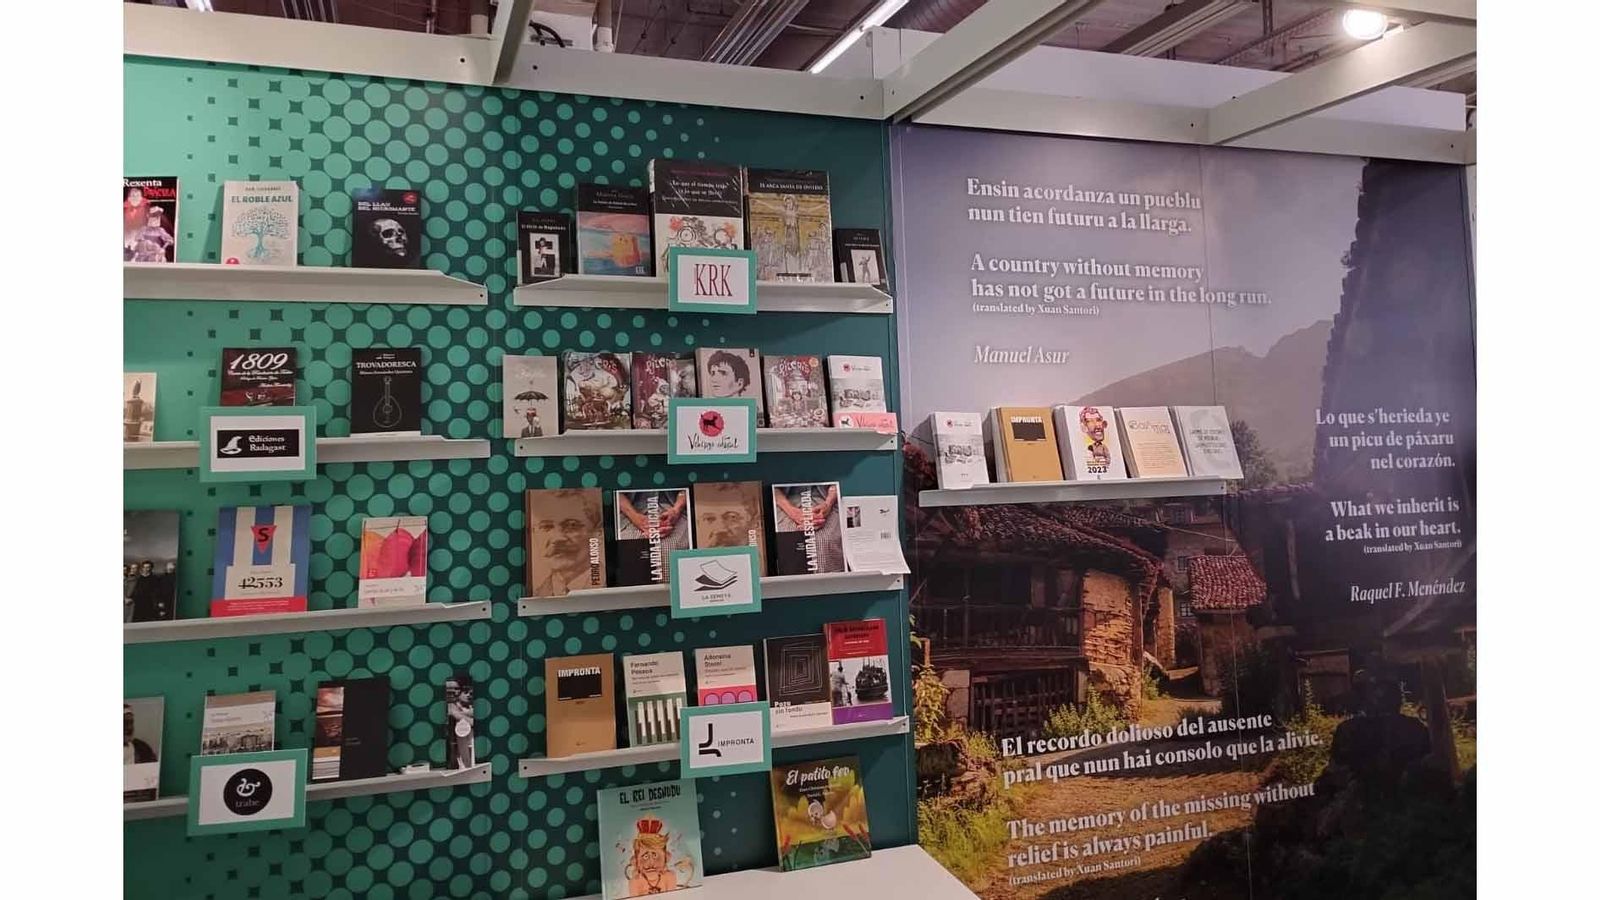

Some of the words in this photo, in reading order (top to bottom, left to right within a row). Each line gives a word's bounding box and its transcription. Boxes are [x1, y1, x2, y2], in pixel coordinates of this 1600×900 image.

[967, 177, 1020, 198] Ensin
[1023, 184, 1115, 205] acordanza
[1119, 190, 1141, 206] un
[1144, 191, 1202, 211] pueblu
[968, 207, 1005, 222] nun
[1009, 206, 1044, 224] tien
[1048, 206, 1104, 228] futuru
[1108, 215, 1118, 228] a
[1121, 212, 1136, 229] la
[1139, 212, 1192, 235] llarga.
[971, 254, 985, 271] A
[988, 255, 1060, 278] country
[1063, 258, 1131, 277] without
[1135, 264, 1204, 283] memory
[694, 262, 733, 298] KRK
[971, 278, 1004, 298] has
[1008, 281, 1039, 299] not
[1043, 283, 1072, 303] got
[1076, 287, 1085, 300] a
[1090, 282, 1144, 302] future
[1148, 285, 1166, 302] in
[1169, 286, 1197, 303] the
[1200, 286, 1237, 308] long
[1239, 291, 1272, 305] run.
[972, 302, 1024, 314] (translated
[1025, 304, 1036, 316] by
[1037, 304, 1062, 315] Xuan
[1063, 304, 1100, 317] Santori)
[230, 352, 289, 370] 1809
[973, 345, 1032, 364] Manuel
[1034, 347, 1070, 364] Asur
[1316, 409, 1335, 425] Lo
[1338, 413, 1367, 428] que
[1368, 408, 1432, 424] s'herieda
[1434, 412, 1450, 426] ye
[250, 444, 286, 453] Radagast
[1329, 434, 1349, 448] un
[1351, 431, 1383, 450] picu
[1386, 430, 1404, 446] de
[1406, 430, 1454, 449] páxaru
[1371, 453, 1394, 469] nel
[1396, 453, 1456, 469] corazón.
[800, 491, 814, 537] ESPLICADA
[1331, 499, 1373, 517] What
[1375, 503, 1395, 515] we
[1397, 497, 1445, 514] inherit
[1447, 496, 1460, 512] is
[648, 496, 660, 544] ESPLICADA
[1325, 530, 1334, 541] a
[1337, 522, 1373, 541] beak
[1375, 523, 1390, 539] in
[1393, 525, 1418, 538] our
[1419, 520, 1461, 537] heart.
[259, 530, 270, 542] S
[589, 537, 600, 564] ALONSO
[650, 546, 662, 567] VIDA
[805, 538, 816, 559] VIDA
[1363, 543, 1404, 554] (translated
[1405, 542, 1413, 555] by
[1414, 541, 1434, 551] Xuan
[1434, 539, 1463, 550] Santori)
[651, 569, 663, 581] LA
[807, 559, 818, 571] LA
[1350, 582, 1393, 604] Raquel
[1395, 582, 1406, 598] F.
[1408, 578, 1466, 597] Menéndez
[558, 666, 601, 677] IMPRONTA
[718, 738, 754, 746] IMPRONTA
[1002, 737, 1023, 757] El
[1027, 729, 1102, 754] recordo
[1107, 722, 1174, 745] dolioso
[1176, 716, 1205, 737] del
[1208, 712, 1273, 732] ausente
[1003, 764, 1042, 789] pral
[1046, 761, 1080, 781] que
[1084, 757, 1120, 774] nun
[1123, 749, 1152, 769] hai
[1155, 741, 1223, 766] consolo
[1226, 741, 1257, 761] que
[1260, 735, 1274, 753] la
[1277, 731, 1324, 751] alivie.
[786, 769, 799, 785] El
[800, 766, 830, 785] patito
[619, 791, 630, 804] EL
[632, 789, 645, 802] REI
[1007, 819, 1045, 840] The
[1049, 810, 1126, 836] memory
[1130, 800, 1151, 822] of
[1151, 797, 1181, 819] the
[1184, 791, 1251, 814] missing
[1252, 782, 1316, 805] without
[1007, 840, 1062, 868] relief
[1064, 838, 1079, 859] is
[1082, 831, 1141, 857] always
[1144, 821, 1213, 851] painful.
[1008, 864, 1065, 887] (translated
[1065, 863, 1076, 877] by
[1076, 860, 1102, 876] Xuan
[1103, 856, 1142, 872] Santori)
